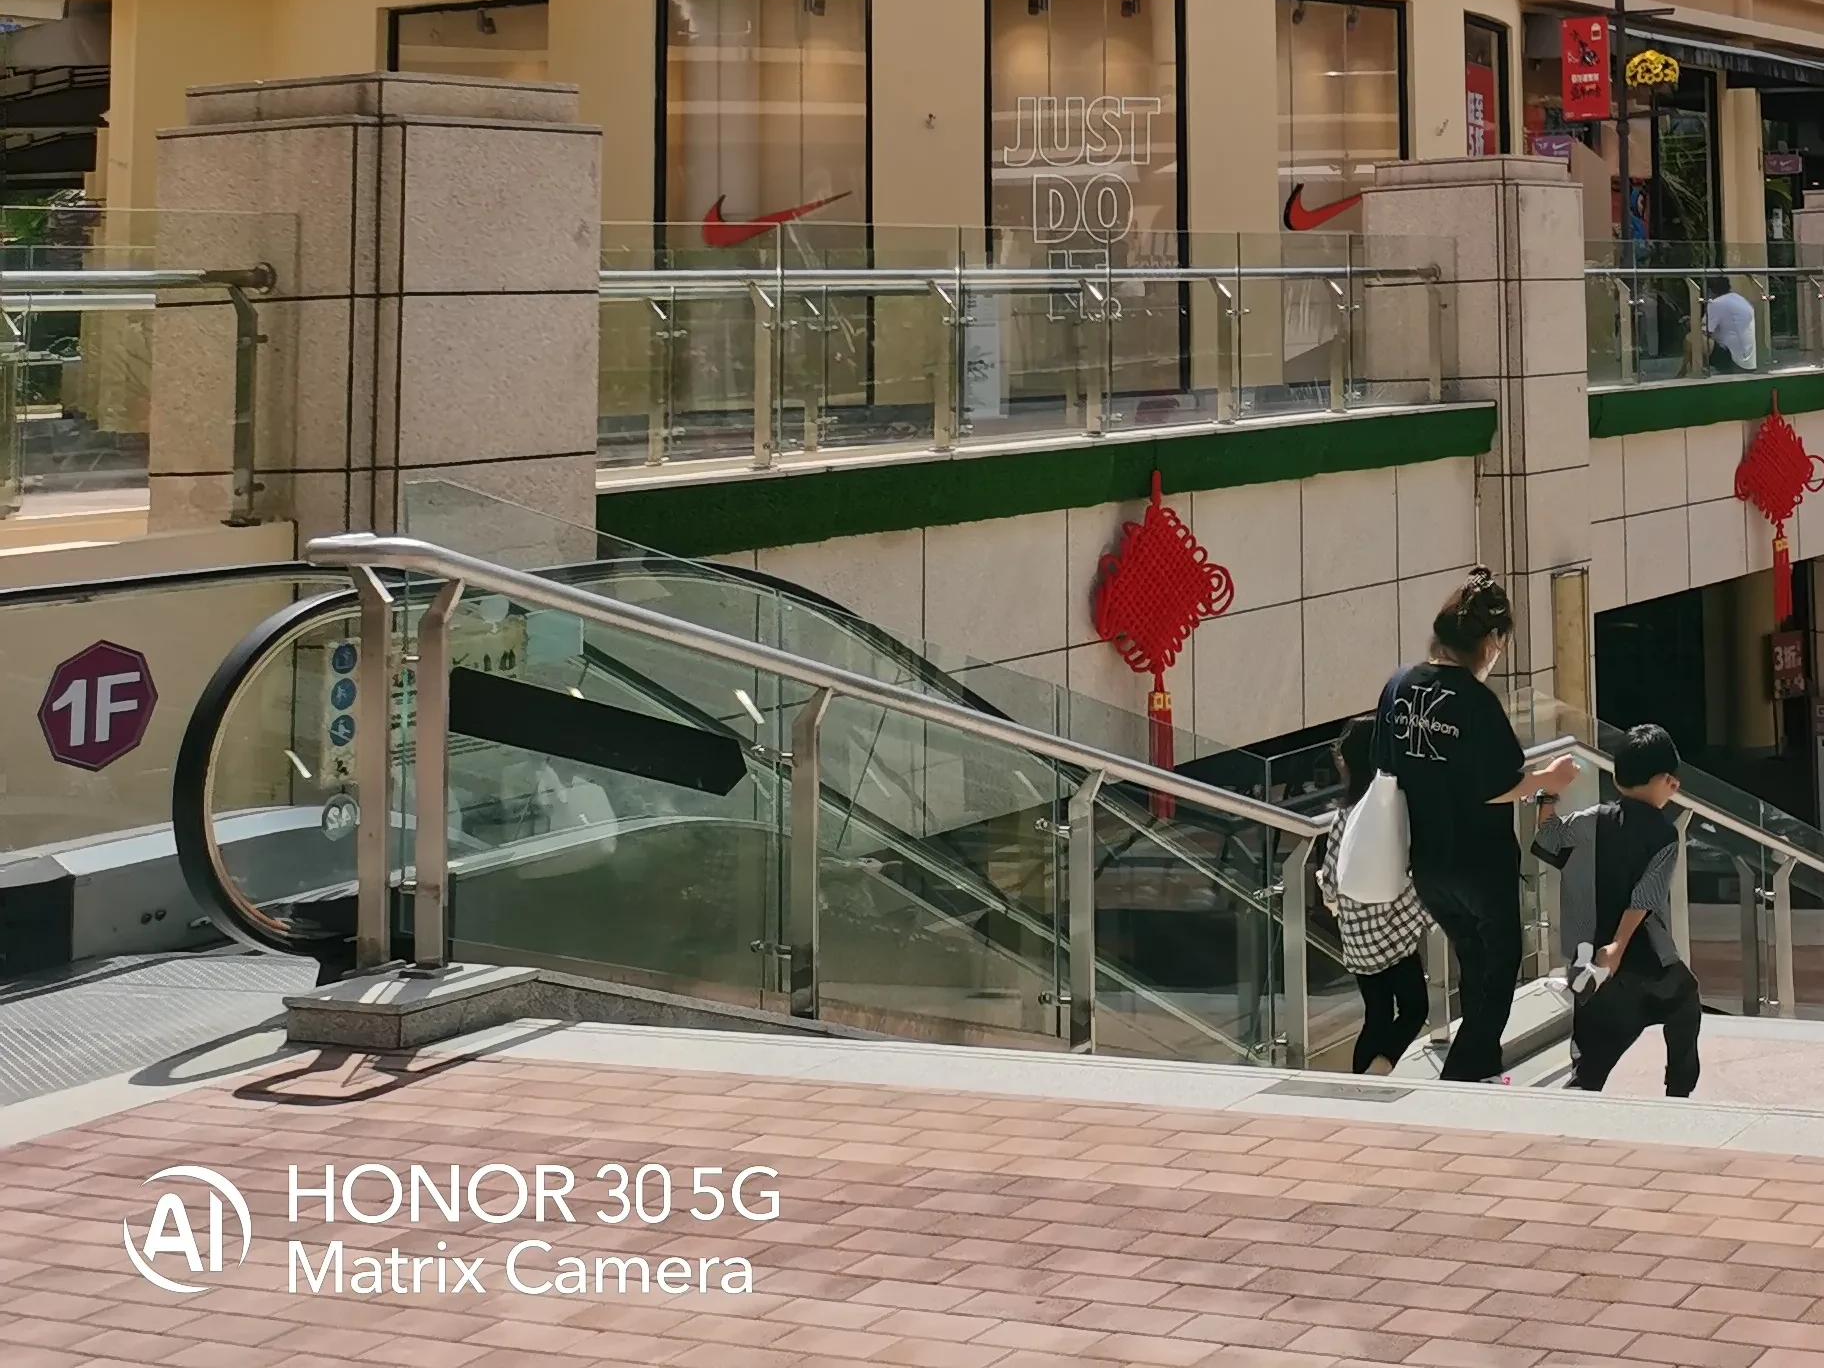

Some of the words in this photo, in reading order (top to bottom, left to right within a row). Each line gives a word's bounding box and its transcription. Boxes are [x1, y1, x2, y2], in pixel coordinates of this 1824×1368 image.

[1003, 96, 1161, 167] JUST
[1033, 173, 1133, 244] DO
[52, 671, 140, 747] 1F
